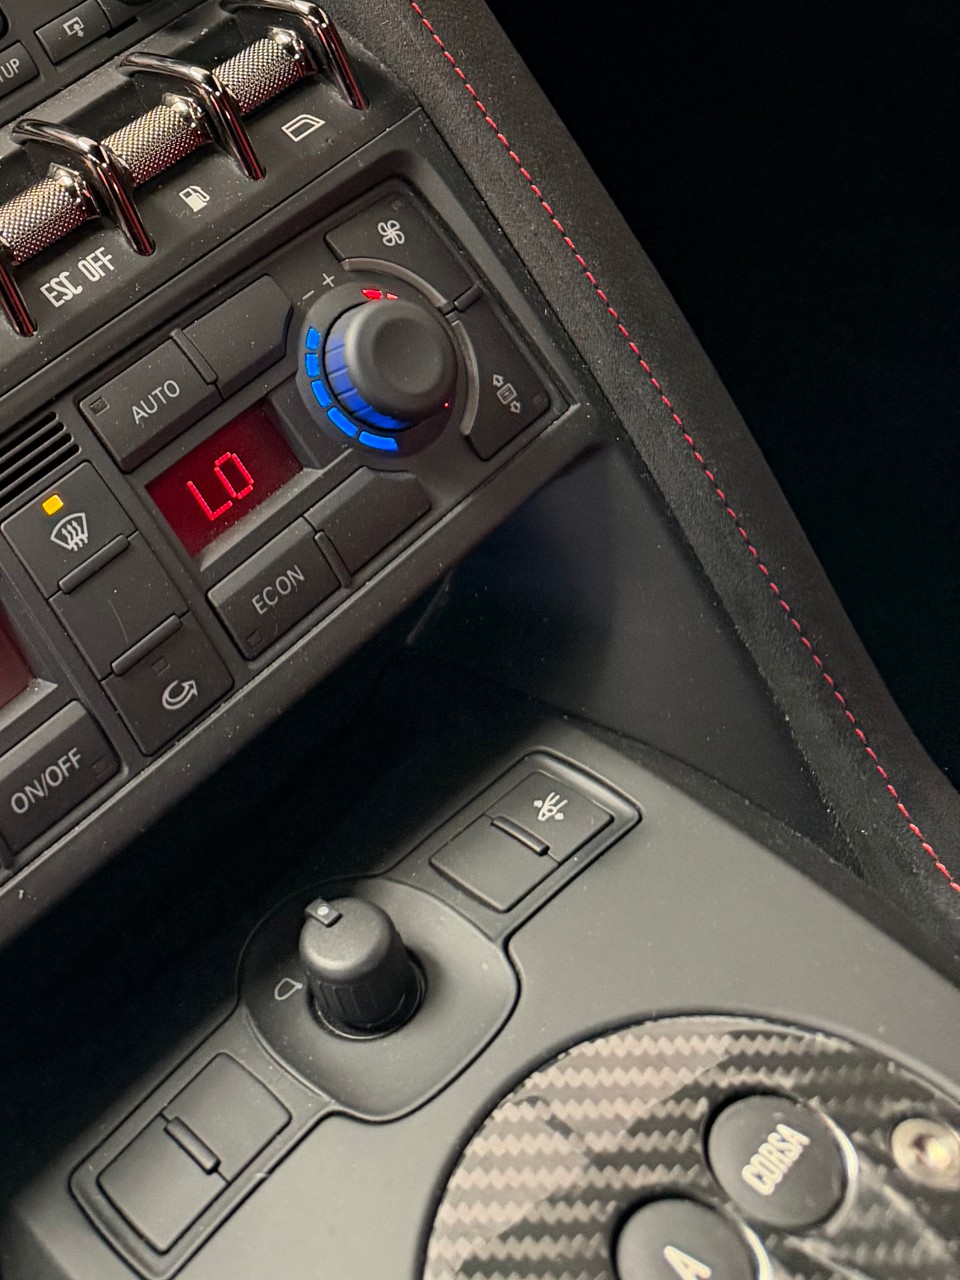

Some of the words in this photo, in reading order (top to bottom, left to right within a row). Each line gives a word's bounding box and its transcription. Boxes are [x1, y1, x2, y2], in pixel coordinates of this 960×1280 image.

[40, 274, 83, 308] ESC
[77, 247, 115, 282] OFF
[130, 379, 181, 424] AUTO
[186, 451, 254, 521] LO
[250, 565, 305, 616] ECON
[9, 748, 84, 815] ON/OFF
[741, 1123, 810, 1195] CORSA
[663, 1245, 712, 1280] A
